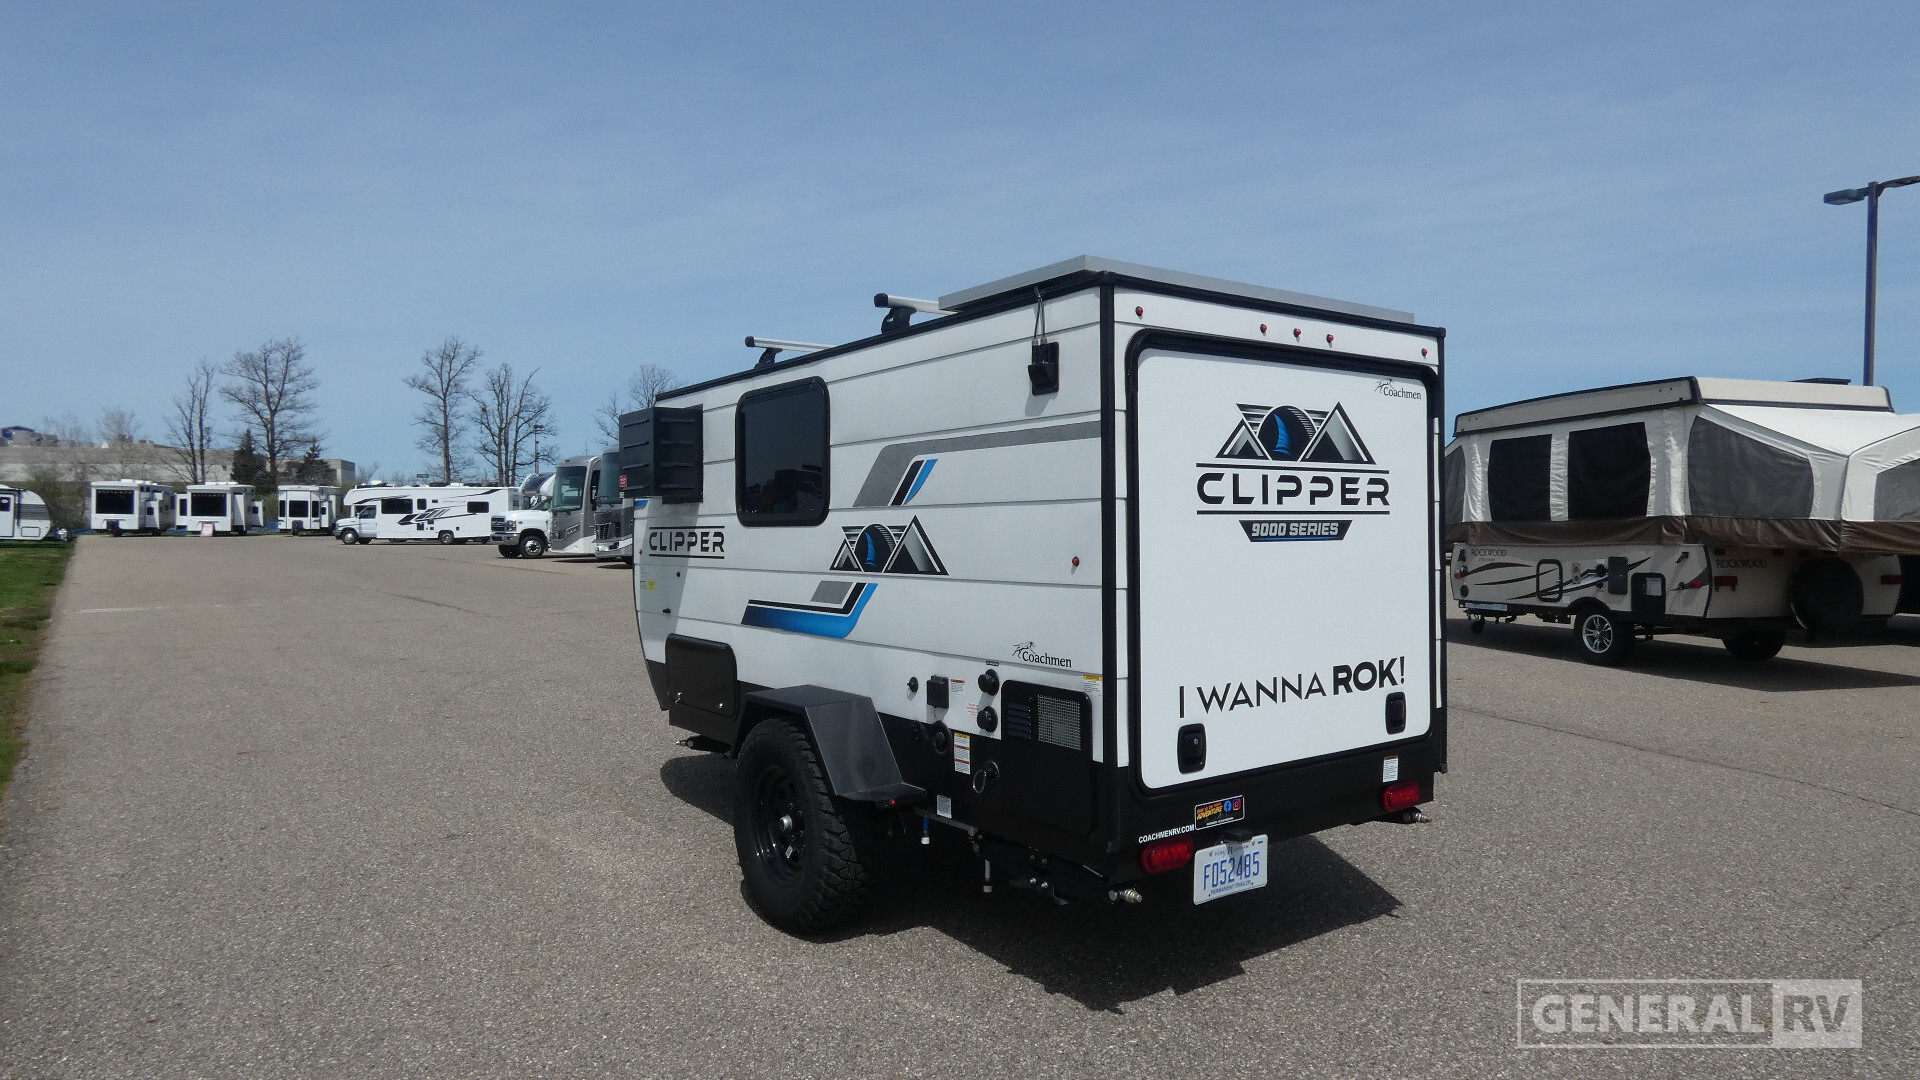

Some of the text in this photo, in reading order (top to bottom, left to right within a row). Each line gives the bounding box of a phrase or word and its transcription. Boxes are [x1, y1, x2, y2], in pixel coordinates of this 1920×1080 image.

[1383, 386, 1422, 400] Coachmen
[1196, 472, 1391, 506] CLIPPER
[1251, 522, 1339, 537] 9000 SERIES
[648, 531, 725, 553] CLIPPER
[1022, 650, 1073, 668] Coachmen
[1179, 656, 1405, 719] I WANNA ROK!
[1138, 823, 1195, 844] COACHMENRV.COM
